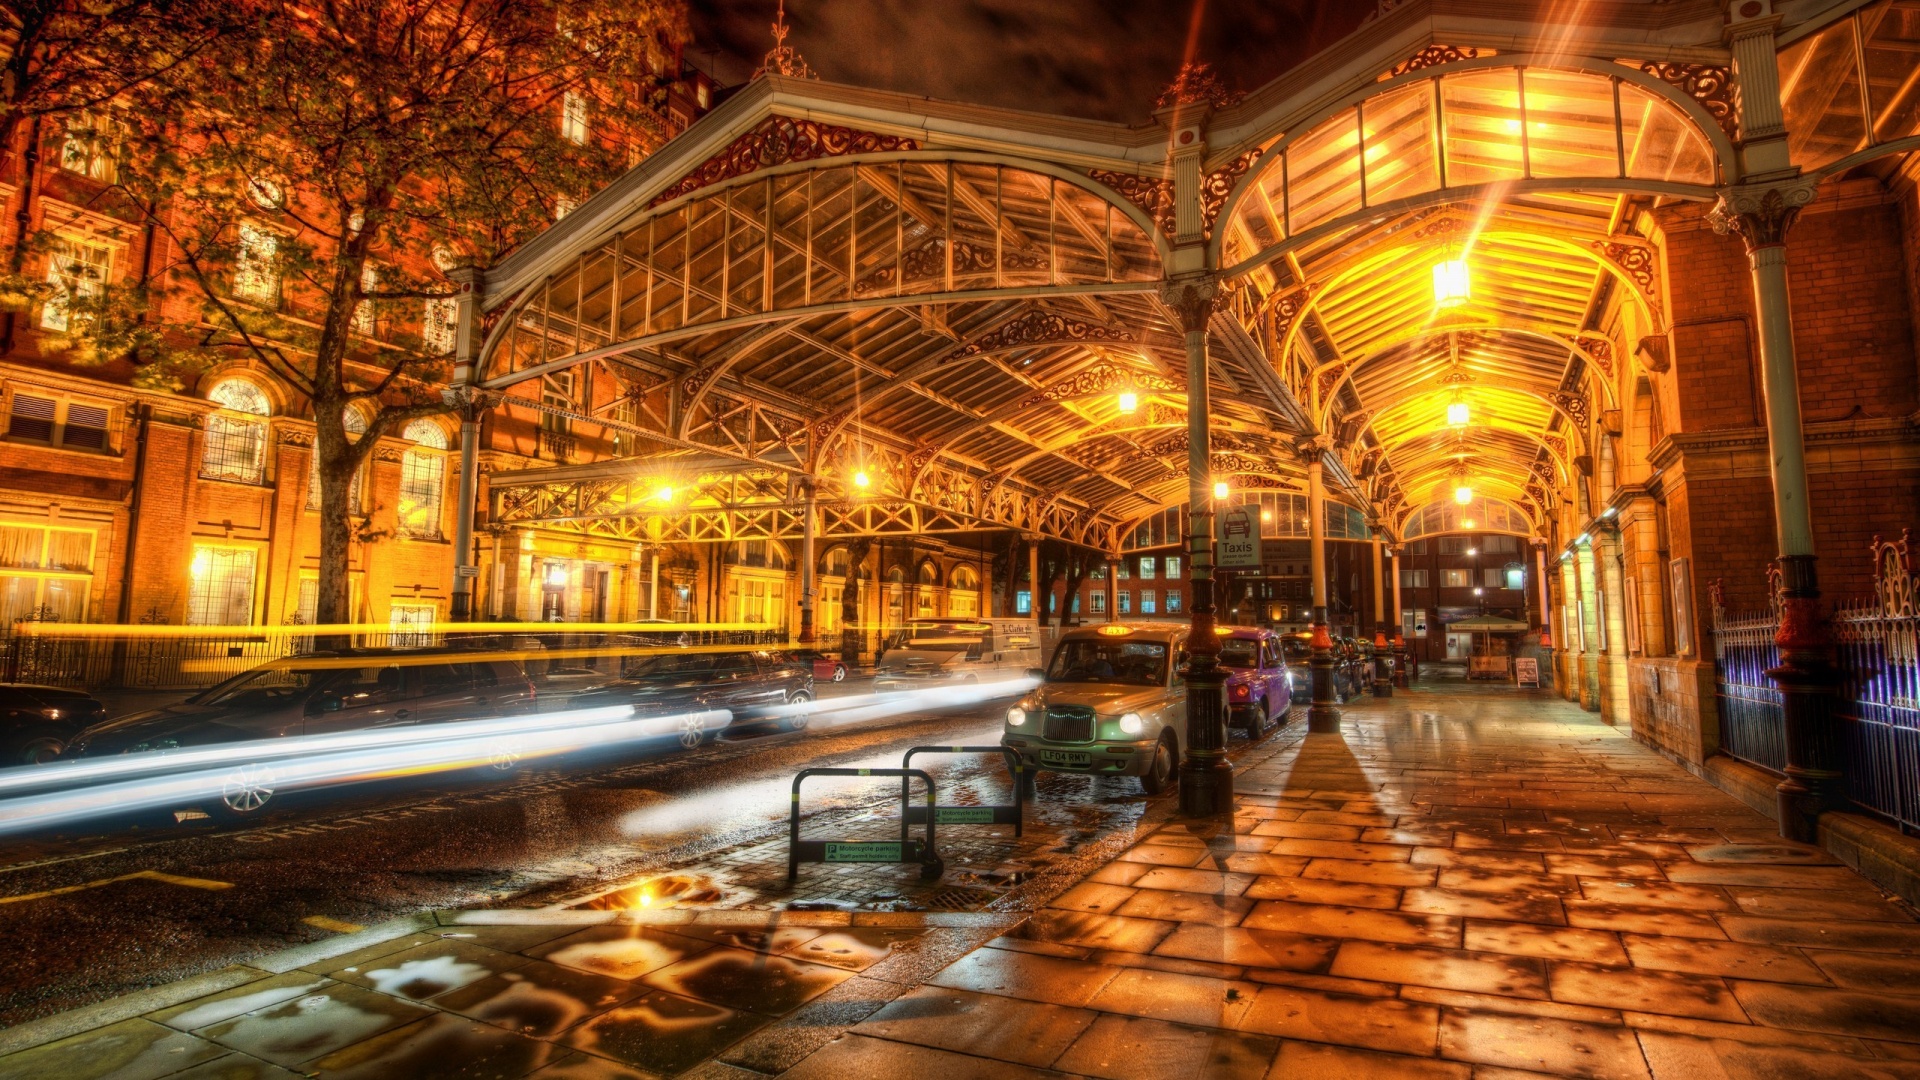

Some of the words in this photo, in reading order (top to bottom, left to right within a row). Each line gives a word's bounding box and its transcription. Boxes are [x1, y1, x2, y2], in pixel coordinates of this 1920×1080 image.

[1222, 542, 1252, 553] Taxis
[1009, 624, 1024, 632] Clarke
[1104, 627, 1125, 635] TAXI
[1044, 750, 1067, 761] LF04
[1068, 753, 1086, 762] RMY
